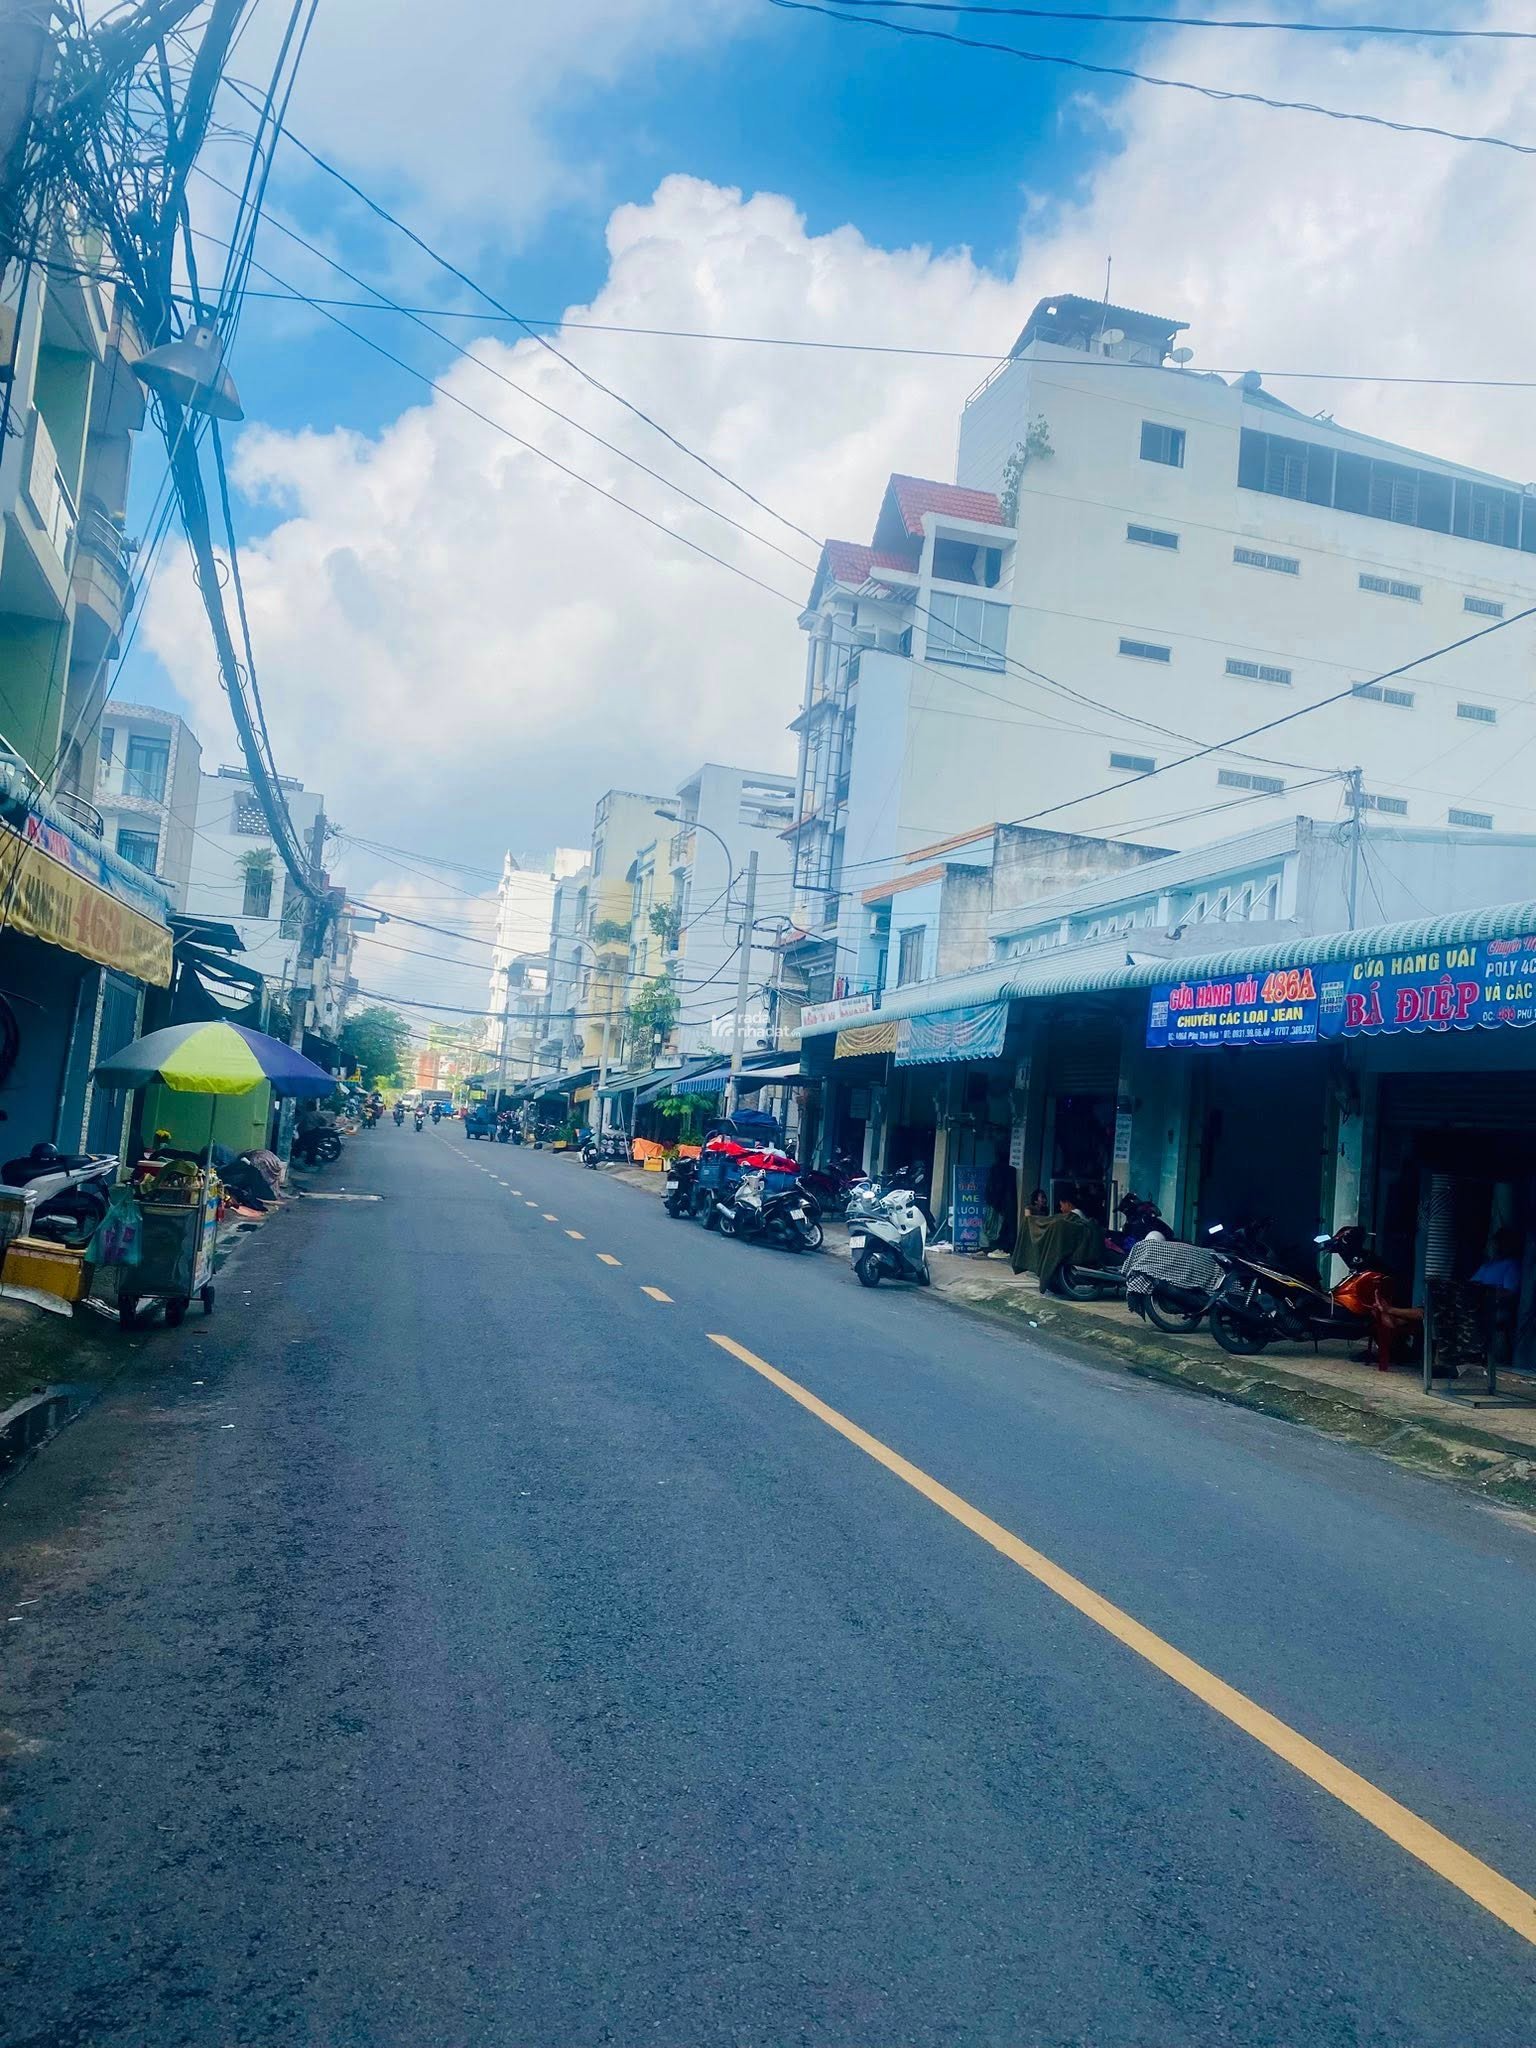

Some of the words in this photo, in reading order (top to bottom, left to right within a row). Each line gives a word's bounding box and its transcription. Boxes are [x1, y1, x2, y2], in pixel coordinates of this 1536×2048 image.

[1485, 960, 1518, 978] POLY
[1197, 981, 1232, 1009] HÀNG
[1261, 967, 1316, 1003] 486A
[1485, 982, 1501, 1002] VÀ
[1506, 980, 1533, 1000] CÁC
[1344, 981, 1384, 1028] BÁ
[1394, 973, 1480, 1030] ĐIỆP
[1177, 1012, 1217, 1028] CHUYÊN
[1219, 1009, 1240, 1026] CÁC
[1243, 1009, 1268, 1026] LOẠI
[1271, 1007, 1303, 1022] JEAN
